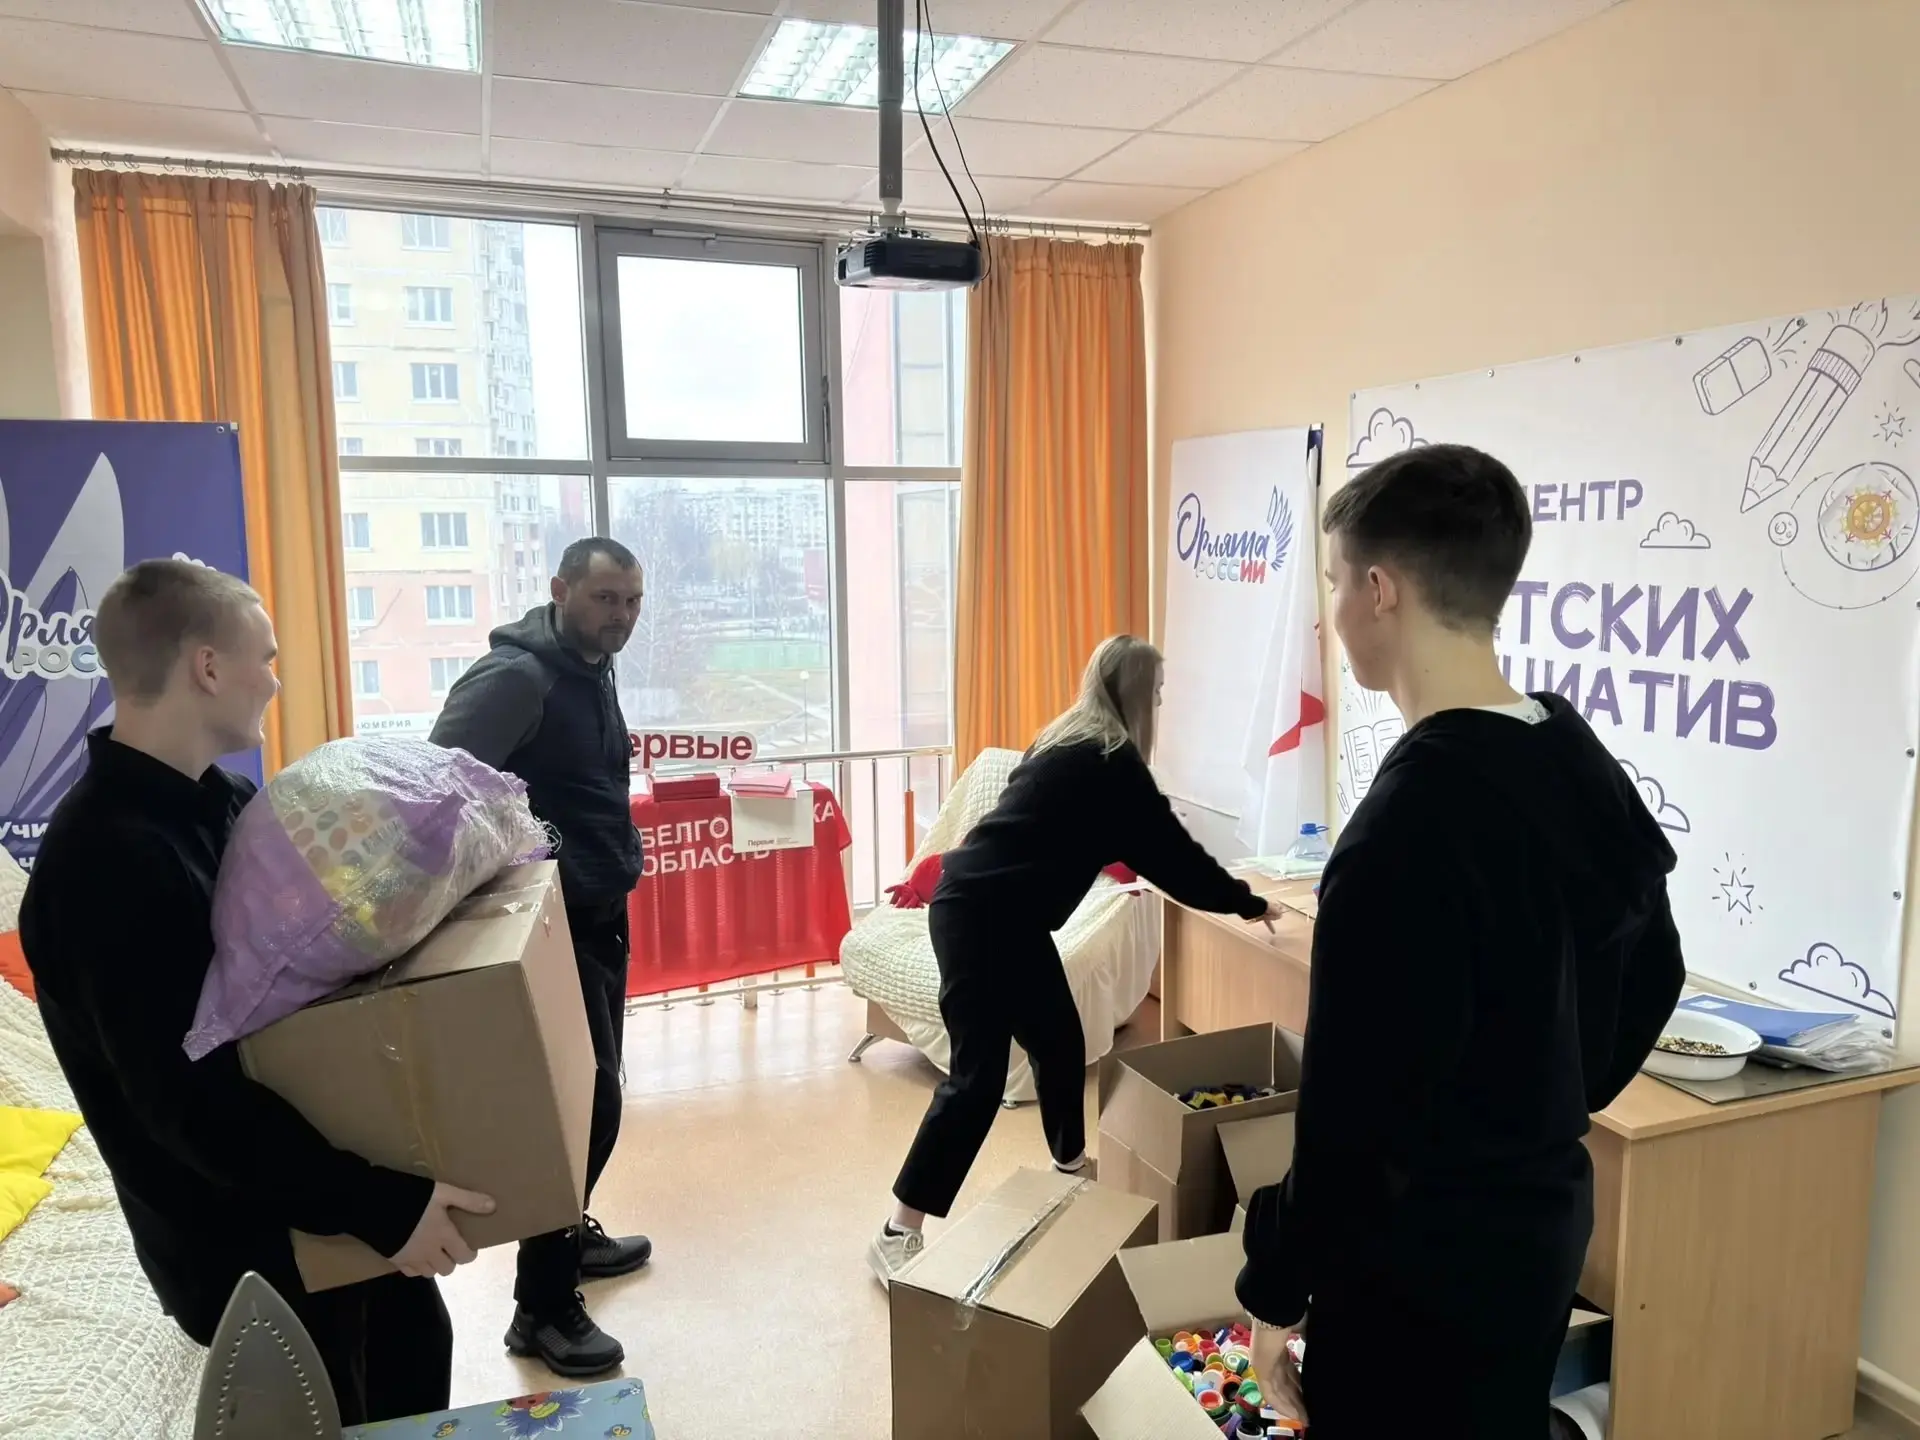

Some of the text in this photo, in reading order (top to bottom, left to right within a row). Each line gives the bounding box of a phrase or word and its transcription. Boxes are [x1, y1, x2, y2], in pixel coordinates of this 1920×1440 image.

[1524, 479, 1644, 522] ЕНТР
[1177, 492, 1271, 570] Орлята
[1195, 558, 1267, 584] РОССИИ
[0, 572, 96, 664] рля
[1494, 580, 1754, 666] ТСКИХ
[13, 645, 107, 674] РОС
[356, 719, 412, 730] ЮМЕРИЯ
[1497, 655, 1778, 751] ИАТИВ
